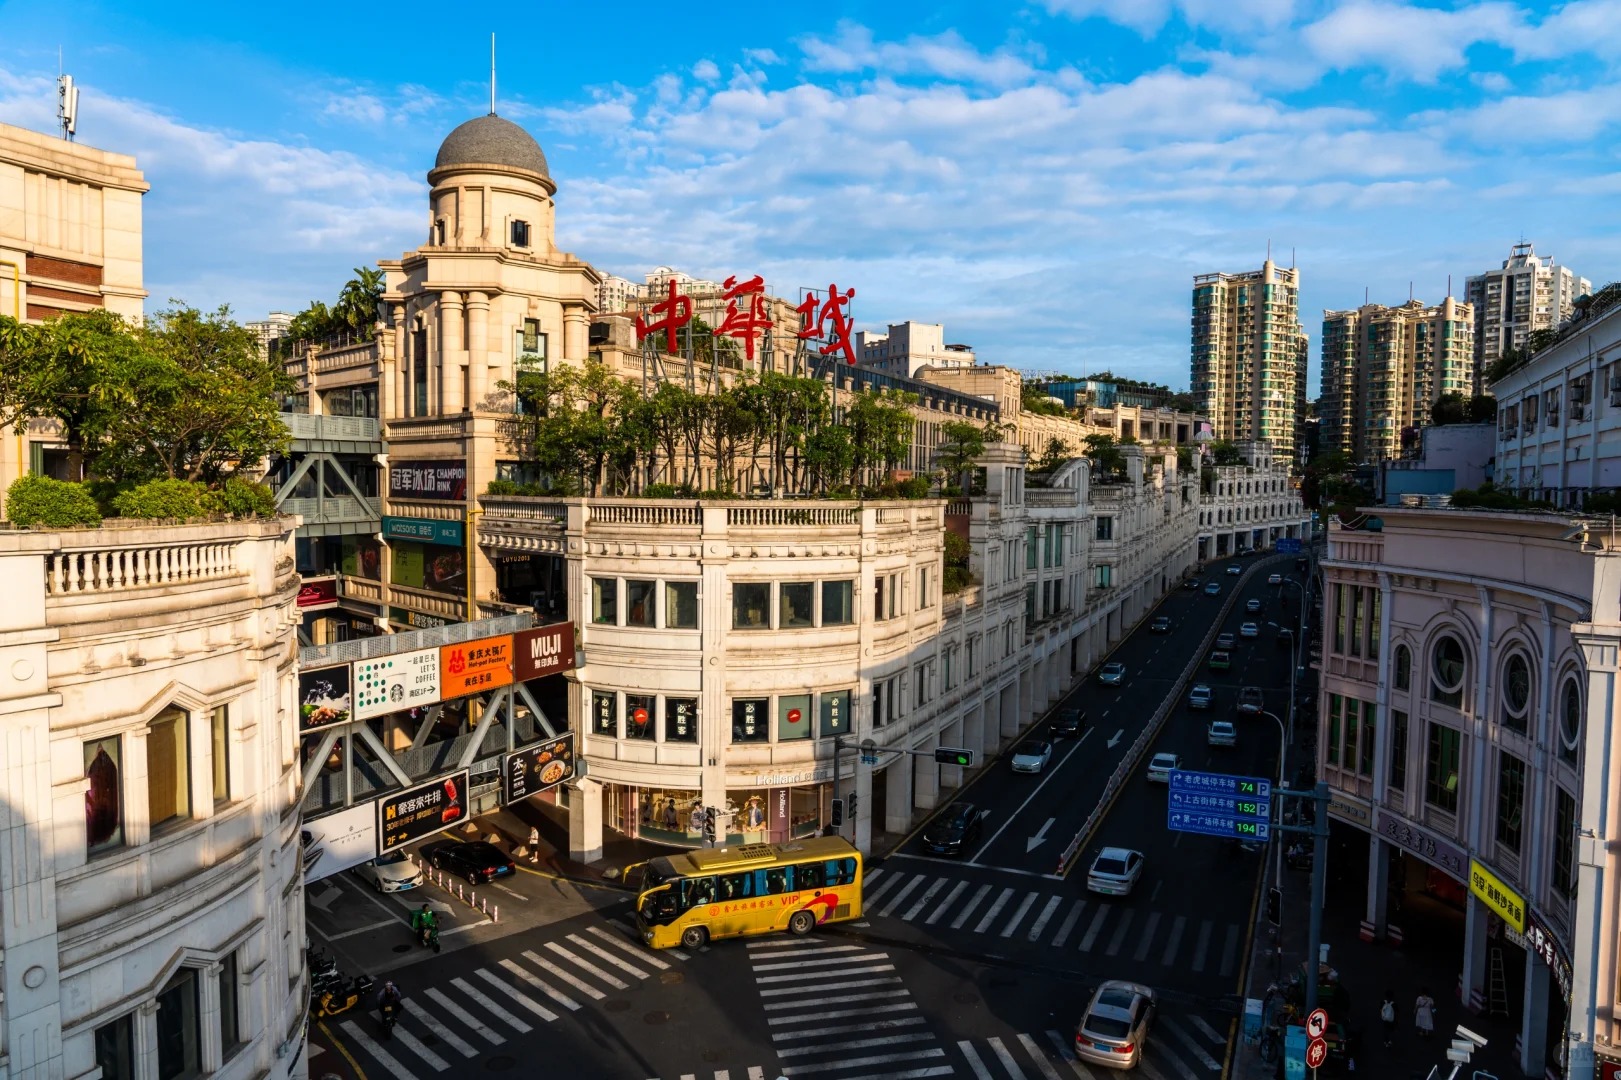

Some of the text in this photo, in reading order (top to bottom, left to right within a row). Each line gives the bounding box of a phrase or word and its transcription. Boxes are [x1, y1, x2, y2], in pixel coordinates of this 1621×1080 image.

[391, 468, 435, 491] 冠军冰场
[436, 468, 466, 479] CHAMPION
[436, 481, 451, 492] RINK
[468, 644, 506, 661] 重庆火锅厂
[531, 633, 562, 659] MUJI
[407, 653, 436, 665] 一起星巴克
[488, 656, 507, 665] Factory
[534, 655, 559, 669] 無印良品
[420, 664, 436, 673] LET'S
[415, 673, 436, 684] COFFEE
[601, 698, 609, 728] 必胜客
[831, 697, 840, 727] 必胜客
[677, 704, 686, 735] 必胜客
[745, 704, 755, 735] 必胜客
[513, 757, 524, 782] 太二
[1184, 775, 1236, 789] 老虎城停车场
[1240, 782, 1254, 792] 74
[398, 789, 442, 816] 豪客来牛排
[1183, 795, 1235, 809] 上古街停车楼
[1237, 802, 1256, 813] 152
[1183, 814, 1234, 829] 第一广场停车楼
[1236, 823, 1255, 833] 194
[387, 835, 396, 846] 2F
[781, 895, 799, 906] VIP
[1311, 1044, 1323, 1063] 停
